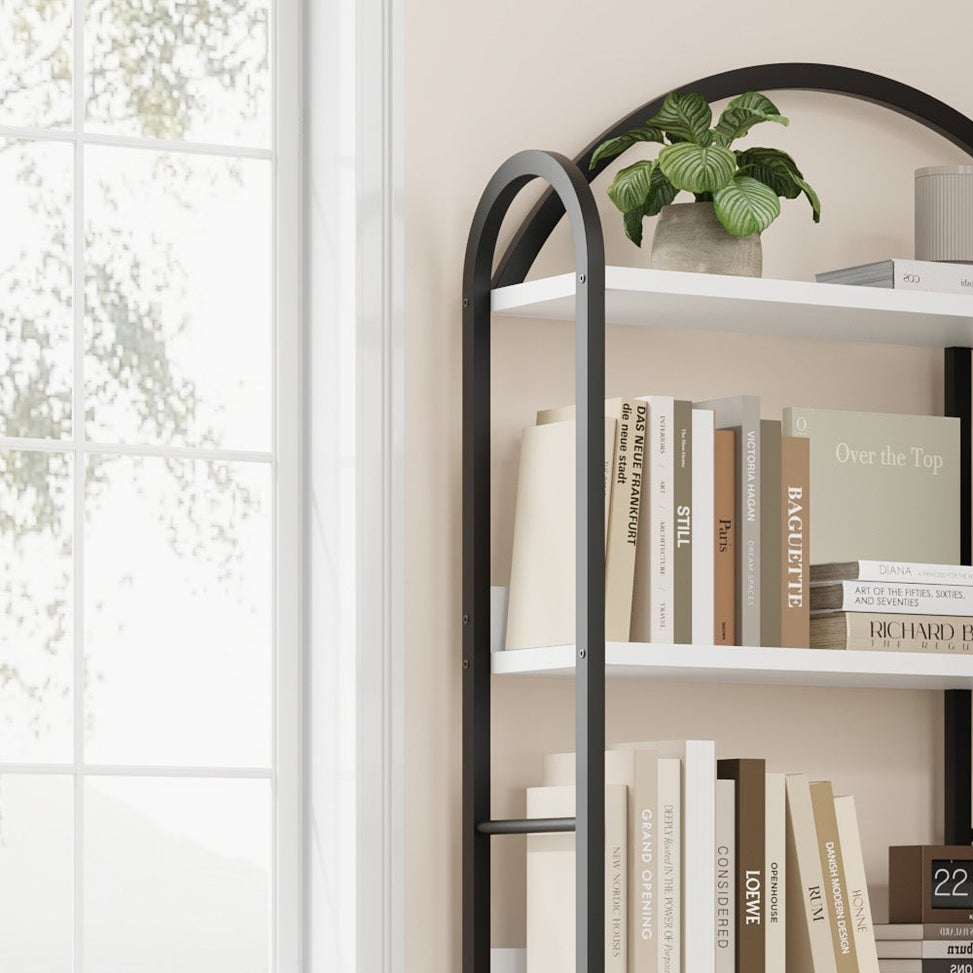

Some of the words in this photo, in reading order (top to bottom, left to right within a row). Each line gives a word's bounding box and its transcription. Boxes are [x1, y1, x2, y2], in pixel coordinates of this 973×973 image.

[622, 402, 632, 421] die
[636, 406, 646, 432] DAS
[620, 425, 630, 452] neue
[632, 435, 644, 468] NEUE
[747, 430, 755, 481] VICTORIA
[617, 455, 627, 484] stadt
[835, 442, 876, 466] Over
[880, 446, 906, 467] the
[910, 447, 943, 476] Top
[627, 471, 642, 546] FRANKFURT
[747, 483, 755, 522] HAGAN
[677, 505, 690, 548] STILL
[718, 519, 731, 553] Paris
[787, 486, 803, 608] BAGUETTE
[880, 564, 912, 576] DIANA
[854, 586, 870, 595] ART
[873, 588, 884, 596] OF
[888, 588, 902, 597] THE
[905, 588, 934, 598] FIFTIES,
[936, 590, 966, 600] SIXTIES,
[854, 597, 874, 605] AND
[876, 597, 920, 607] SEVENTIES
[870, 621, 954, 640] RICHARD
[642, 808, 652, 864] GRAND
[664, 804, 674, 836] DEEPLY
[612, 846, 621, 869] NEW
[826, 841, 836, 872] DANISH
[612, 873, 621, 913] NORDIC
[664, 878, 673, 894] THE
[718, 845, 728, 949] CONSIDERED
[746, 870, 760, 924] LOEWE
[770, 862, 778, 924] OPENHOUSE
[830, 874, 844, 918] MODERN
[934, 868, 969, 897] 22
[642, 870, 652, 940] OPENING
[664, 897, 673, 928] POWER
[808, 885, 824, 922] RUM
[612, 918, 621, 958] HOUSES
[664, 930, 672, 943] OF
[837, 919, 849, 954] DESIGN
